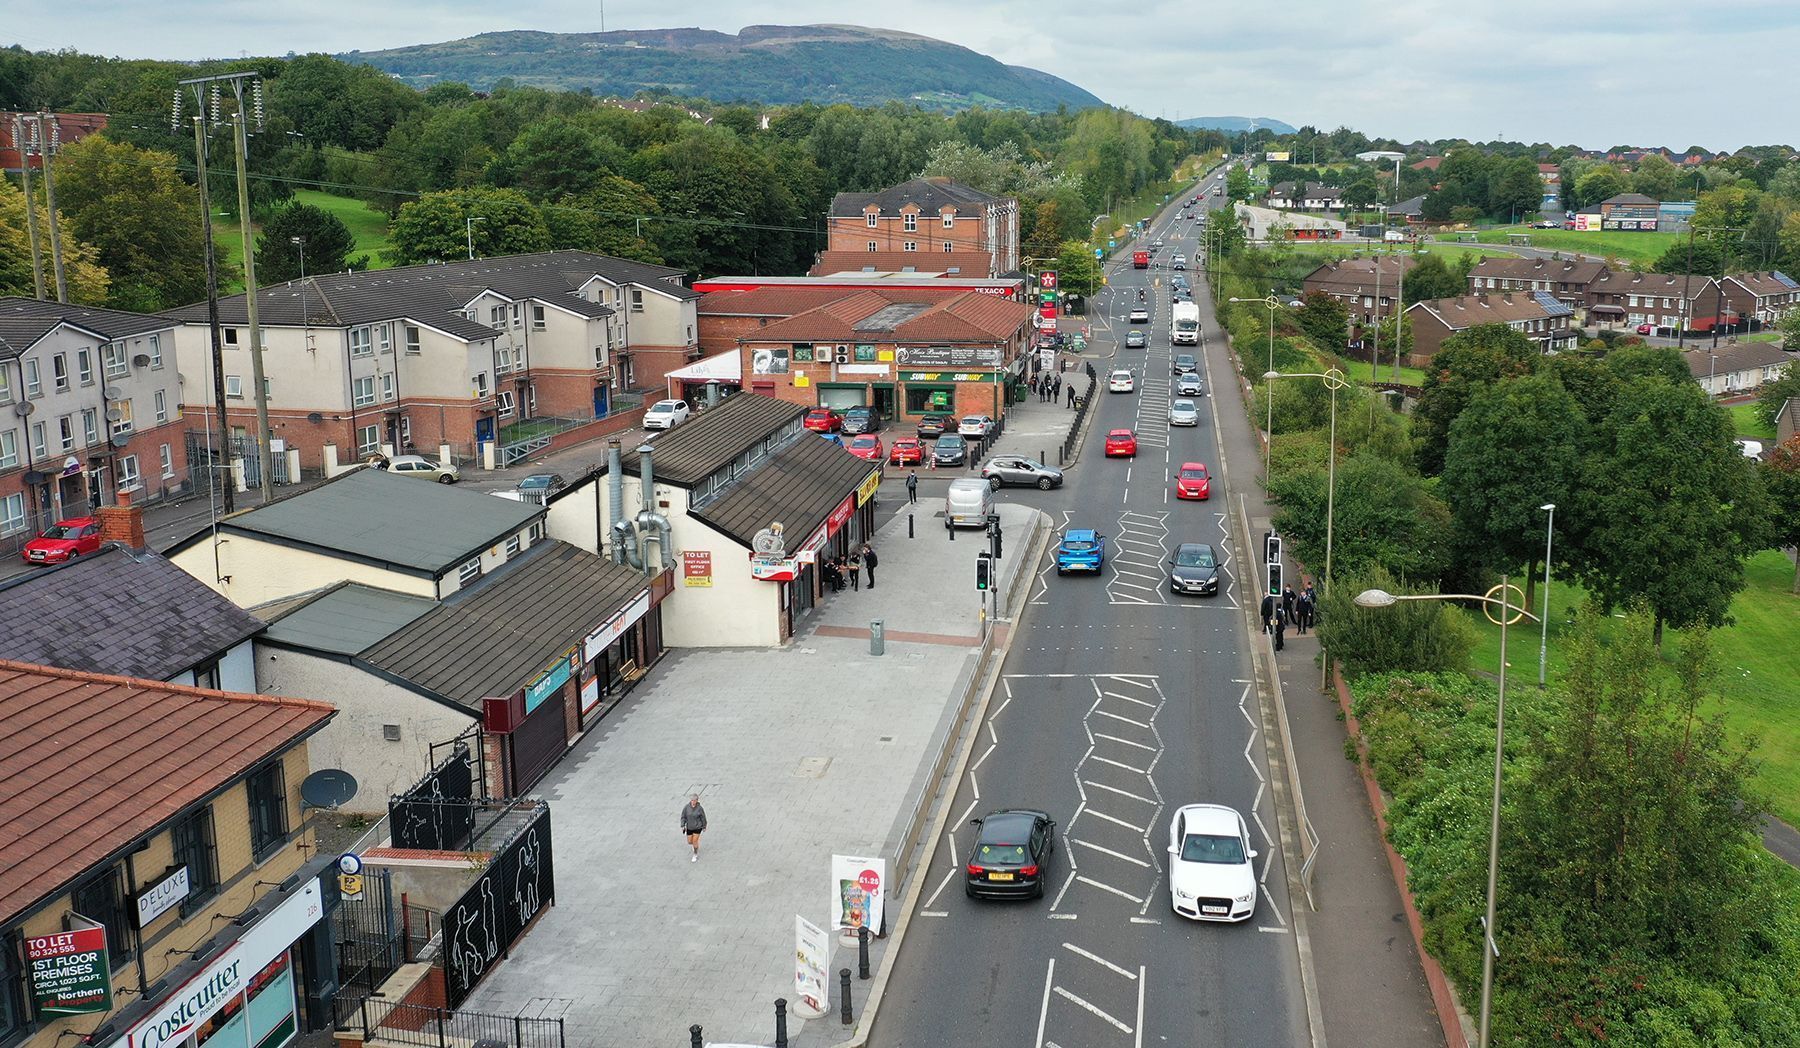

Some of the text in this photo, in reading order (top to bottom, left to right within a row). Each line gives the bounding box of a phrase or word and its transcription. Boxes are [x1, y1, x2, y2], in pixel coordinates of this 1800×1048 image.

[926, 347, 950, 357] Boutique
[952, 373, 984, 381] SUBWAY
[860, 877, 878, 885] £1.25
[140, 870, 185, 912] DELUXE
[308, 905, 317, 917] 226
[27, 934, 73, 949] TO LET
[43, 947, 58, 956] 324
[60, 945, 75, 953] 555
[32, 953, 97, 970] 1ST FLOOR
[33, 964, 93, 981] PREMISES
[35, 981, 58, 989] CIRCA
[59, 977, 77, 985] 1,023
[58, 988, 104, 1000] Northern
[200, 1003, 215, 1018] Proud
[221, 992, 229, 1002] be
[230, 980, 240, 995] local
[59, 995, 104, 1006] Property
[142, 958, 240, 1048] Costcutter
